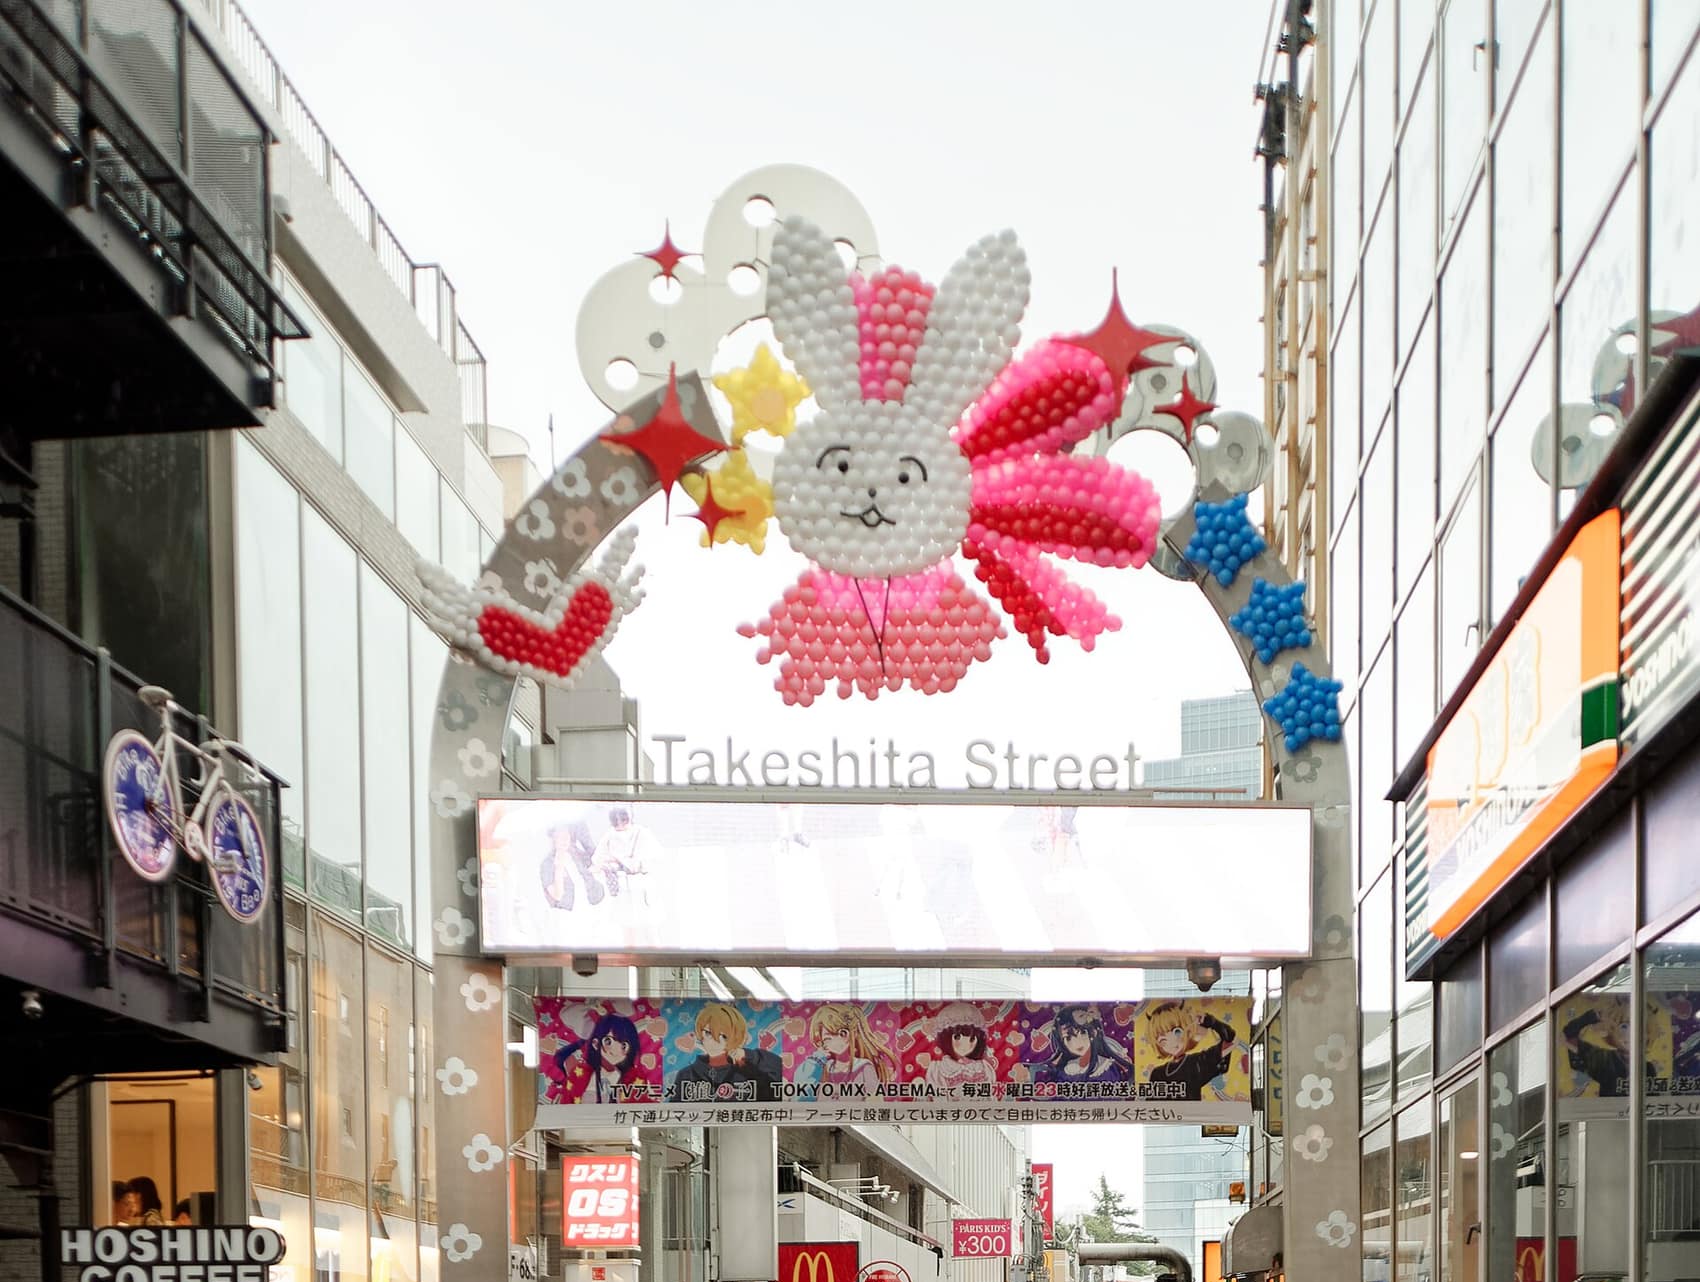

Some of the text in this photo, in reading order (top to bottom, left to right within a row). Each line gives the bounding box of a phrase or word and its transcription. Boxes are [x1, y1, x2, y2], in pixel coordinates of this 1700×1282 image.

[652, 735, 1144, 791] Takeshita Street
[771, 1083, 834, 1098] TOKYO
[614, 1108, 794, 1123] 竹下通りマップ絶賛配布中!
[569, 1164, 626, 1183] クスリ
[567, 1189, 628, 1217] OS
[567, 1223, 629, 1239] ドラッグ
[959, 1225, 983, 1233] PARIS
[61, 1228, 280, 1263] HOSHINO
[959, 1235, 1006, 1255] ¥300
